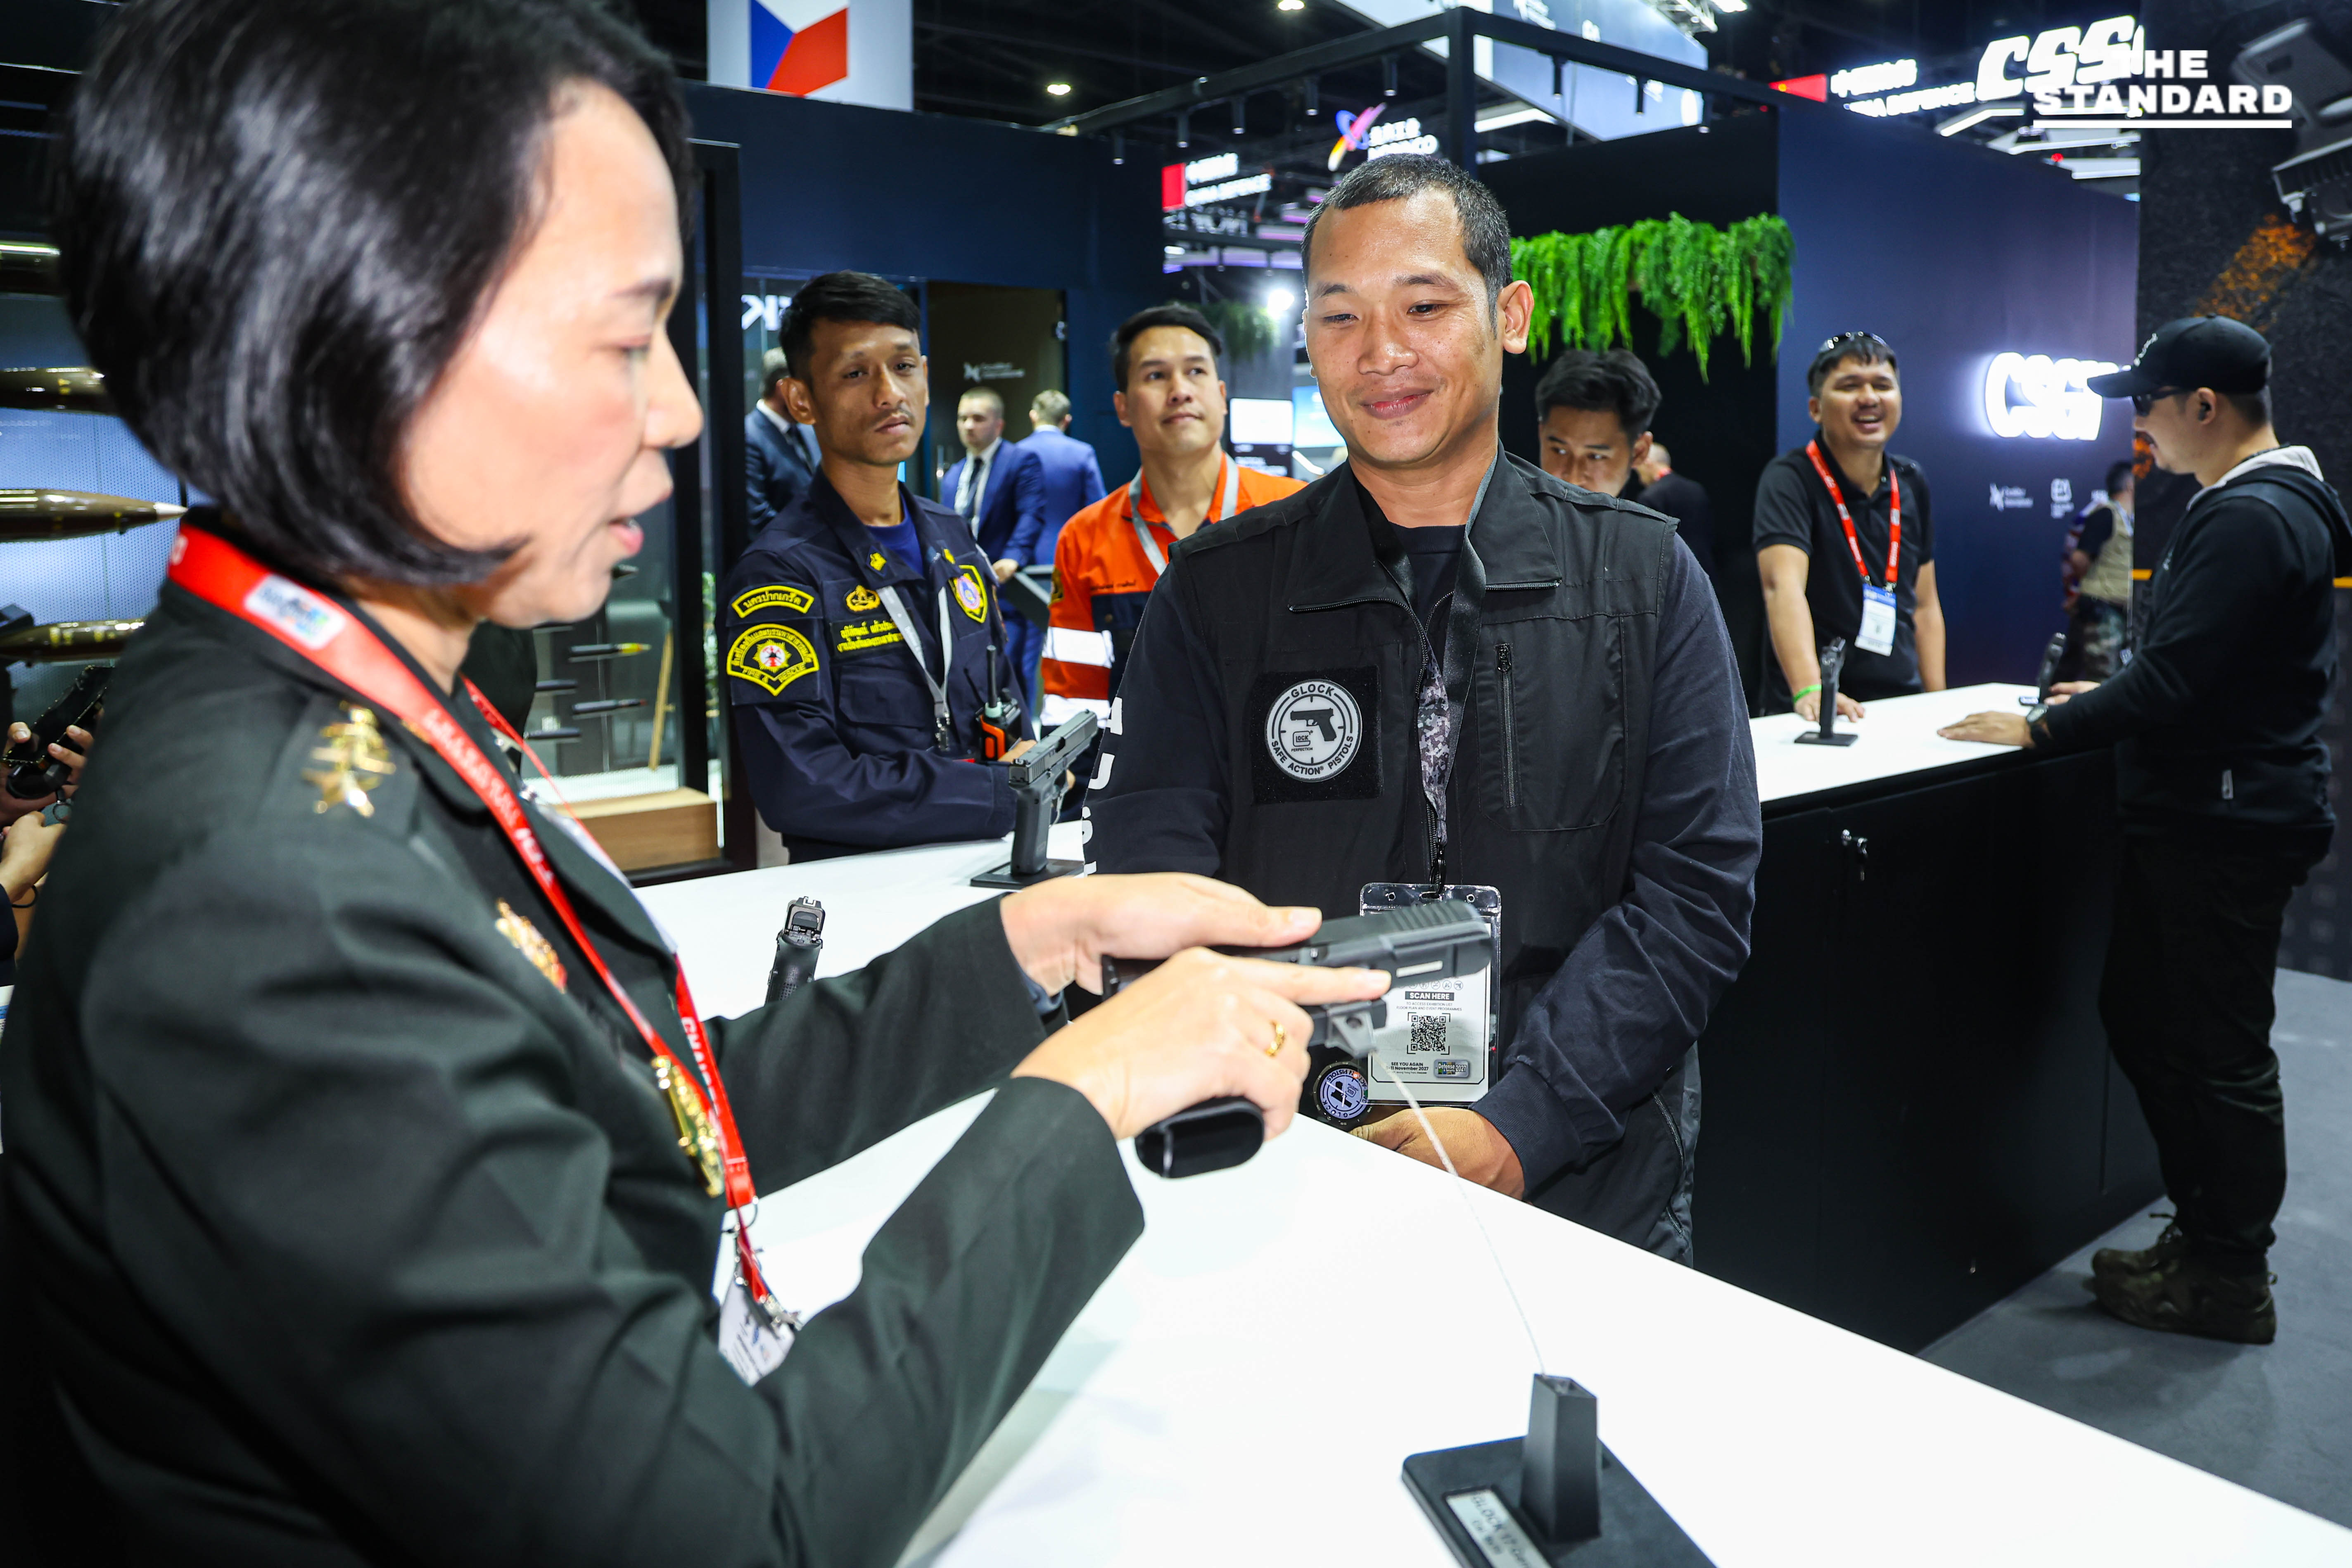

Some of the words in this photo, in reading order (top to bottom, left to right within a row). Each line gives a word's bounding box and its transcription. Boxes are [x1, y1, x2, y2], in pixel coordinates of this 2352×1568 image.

[743, 669, 759, 678] FIRE
[778, 664, 806, 683] RESCUE
[1291, 684, 1335, 698] GLOCK
[1271, 740, 1287, 763] SAFE
[1328, 735, 1354, 770] PISTOLS
[1327, 1070, 1348, 1081] PISTOLS
[1322, 1100, 1348, 1117] GLOCK
